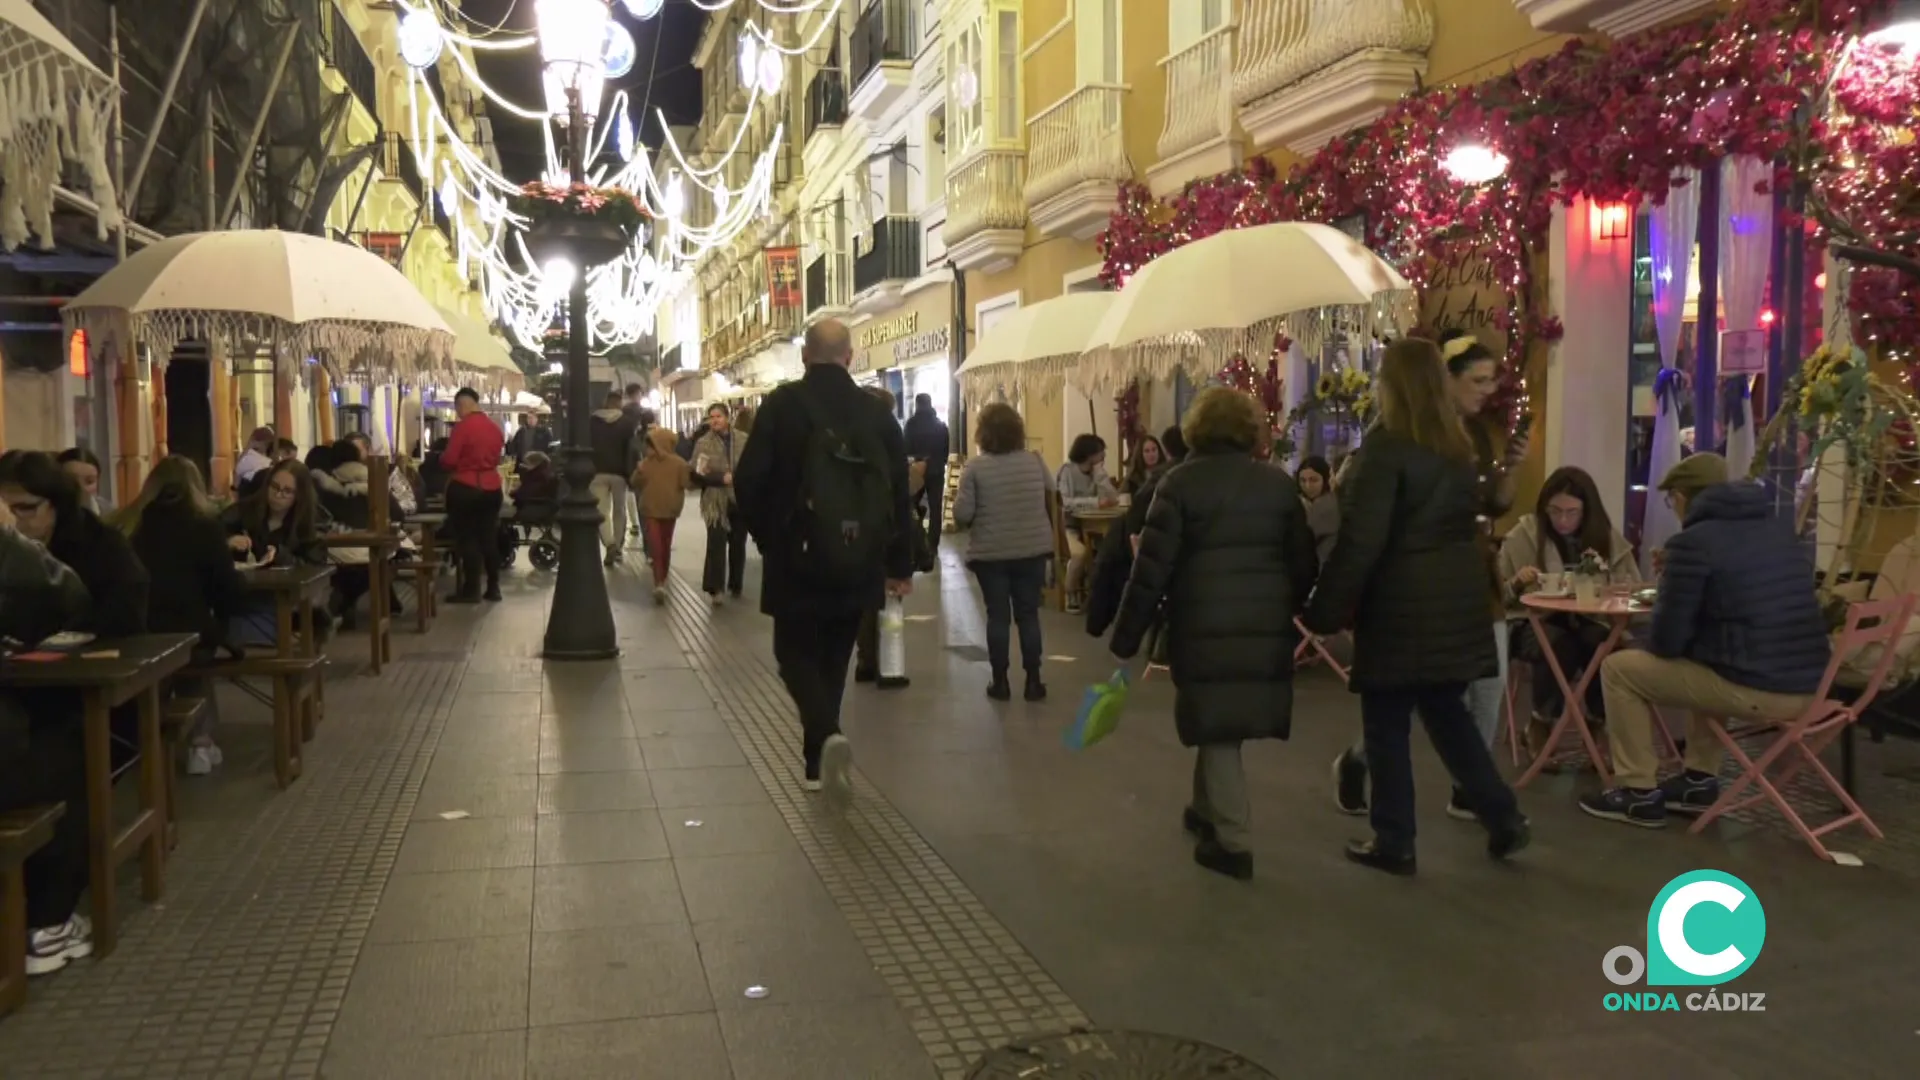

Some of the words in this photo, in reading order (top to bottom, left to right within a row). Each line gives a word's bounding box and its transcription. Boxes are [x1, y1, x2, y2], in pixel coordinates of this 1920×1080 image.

[1459, 246, 1495, 290] Caf
[873, 311, 918, 345] SUPERMARKET
[1432, 296, 1452, 330] de
[893, 326, 947, 361] COMPLEMENTOS
